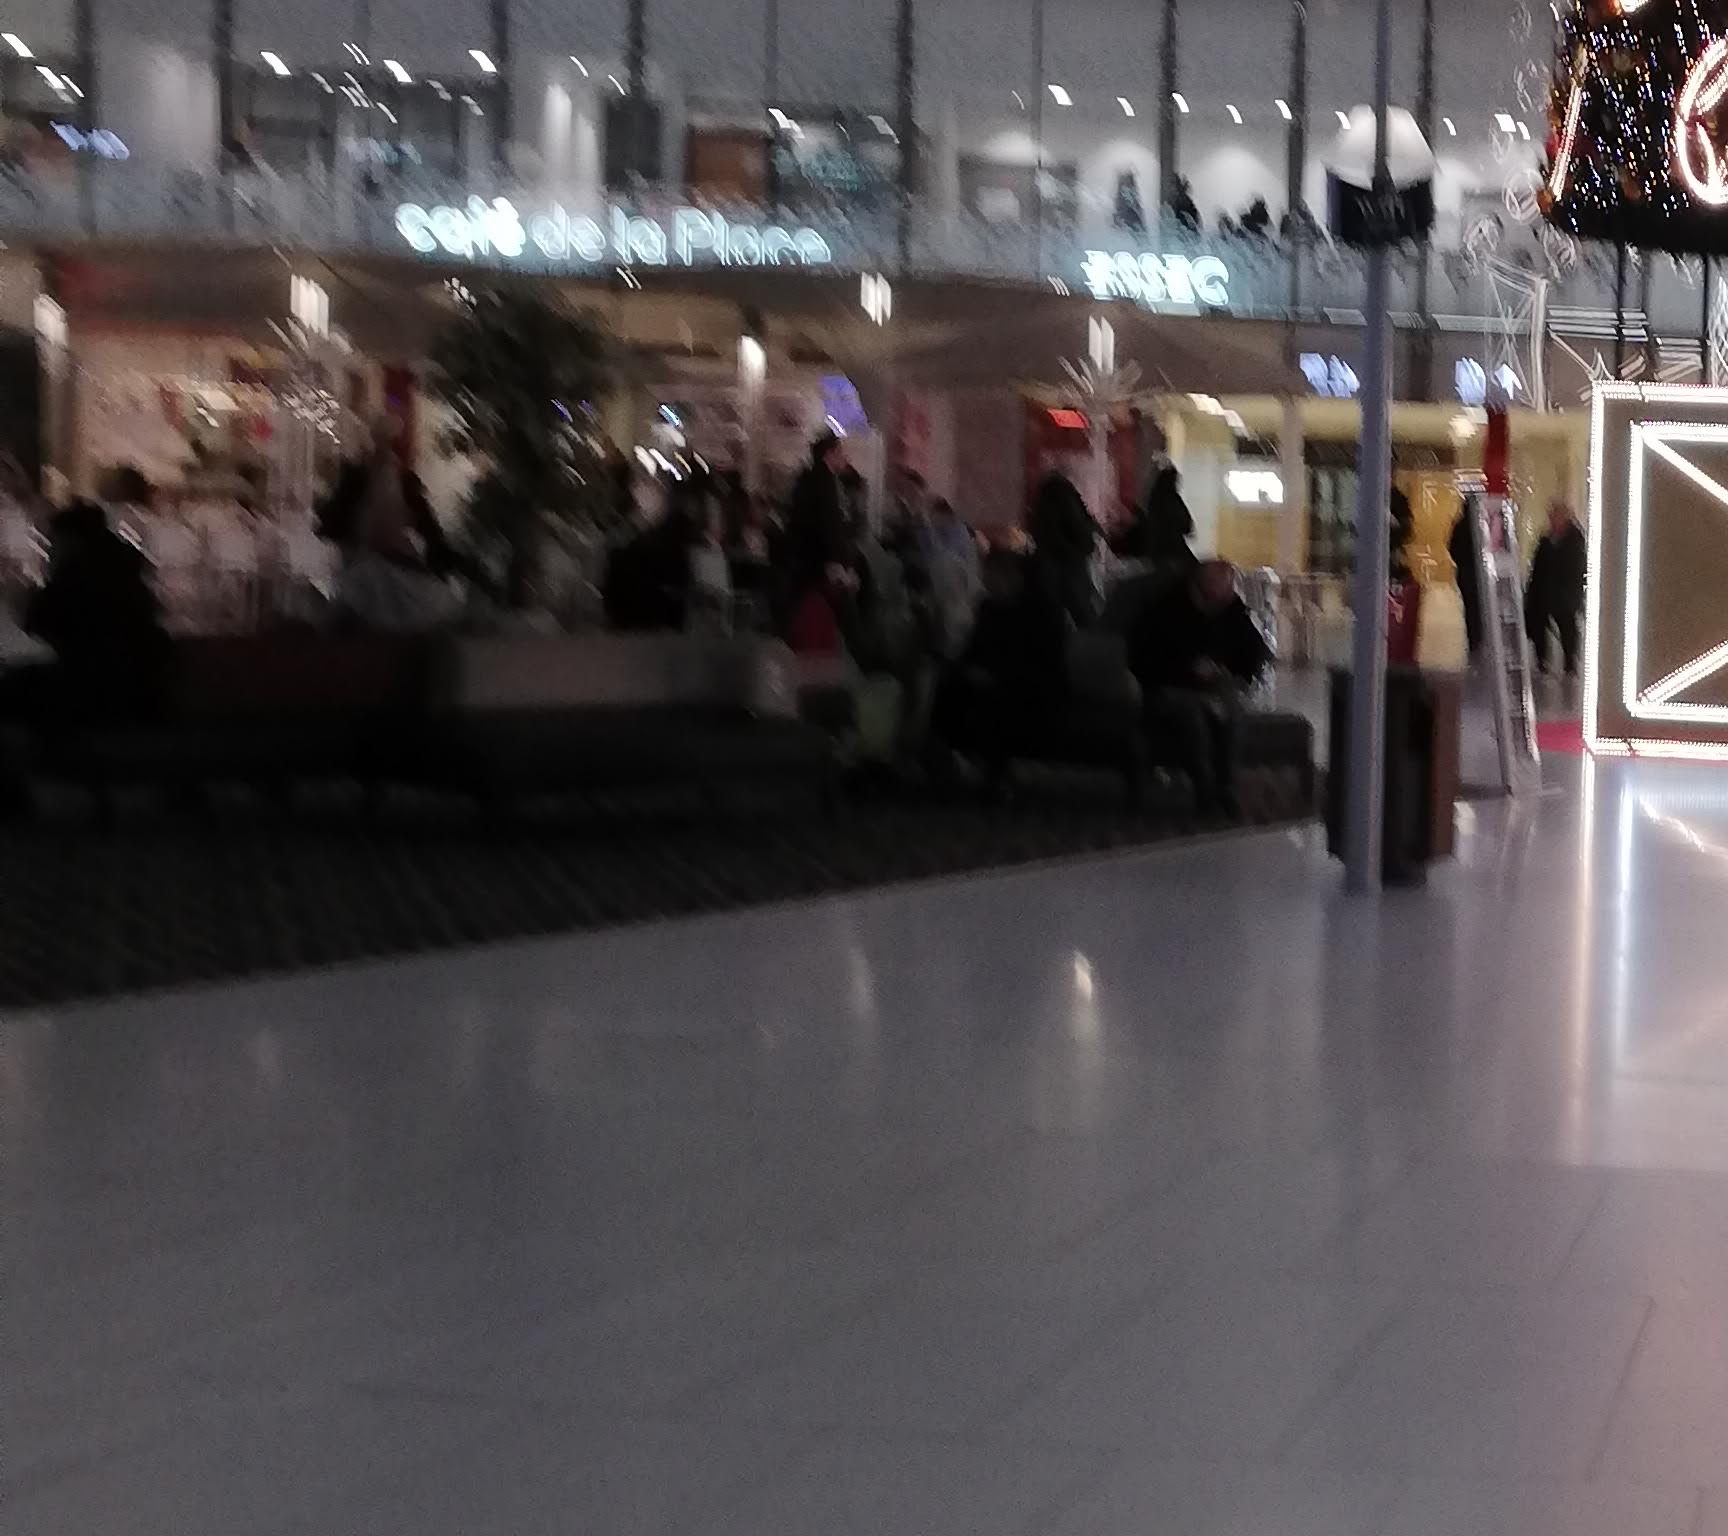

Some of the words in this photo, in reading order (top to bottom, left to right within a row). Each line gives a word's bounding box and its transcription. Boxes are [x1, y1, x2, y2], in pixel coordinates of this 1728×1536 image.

[525, 201, 607, 263] de
[613, 204, 668, 266] la
[671, 206, 832, 266] Place
